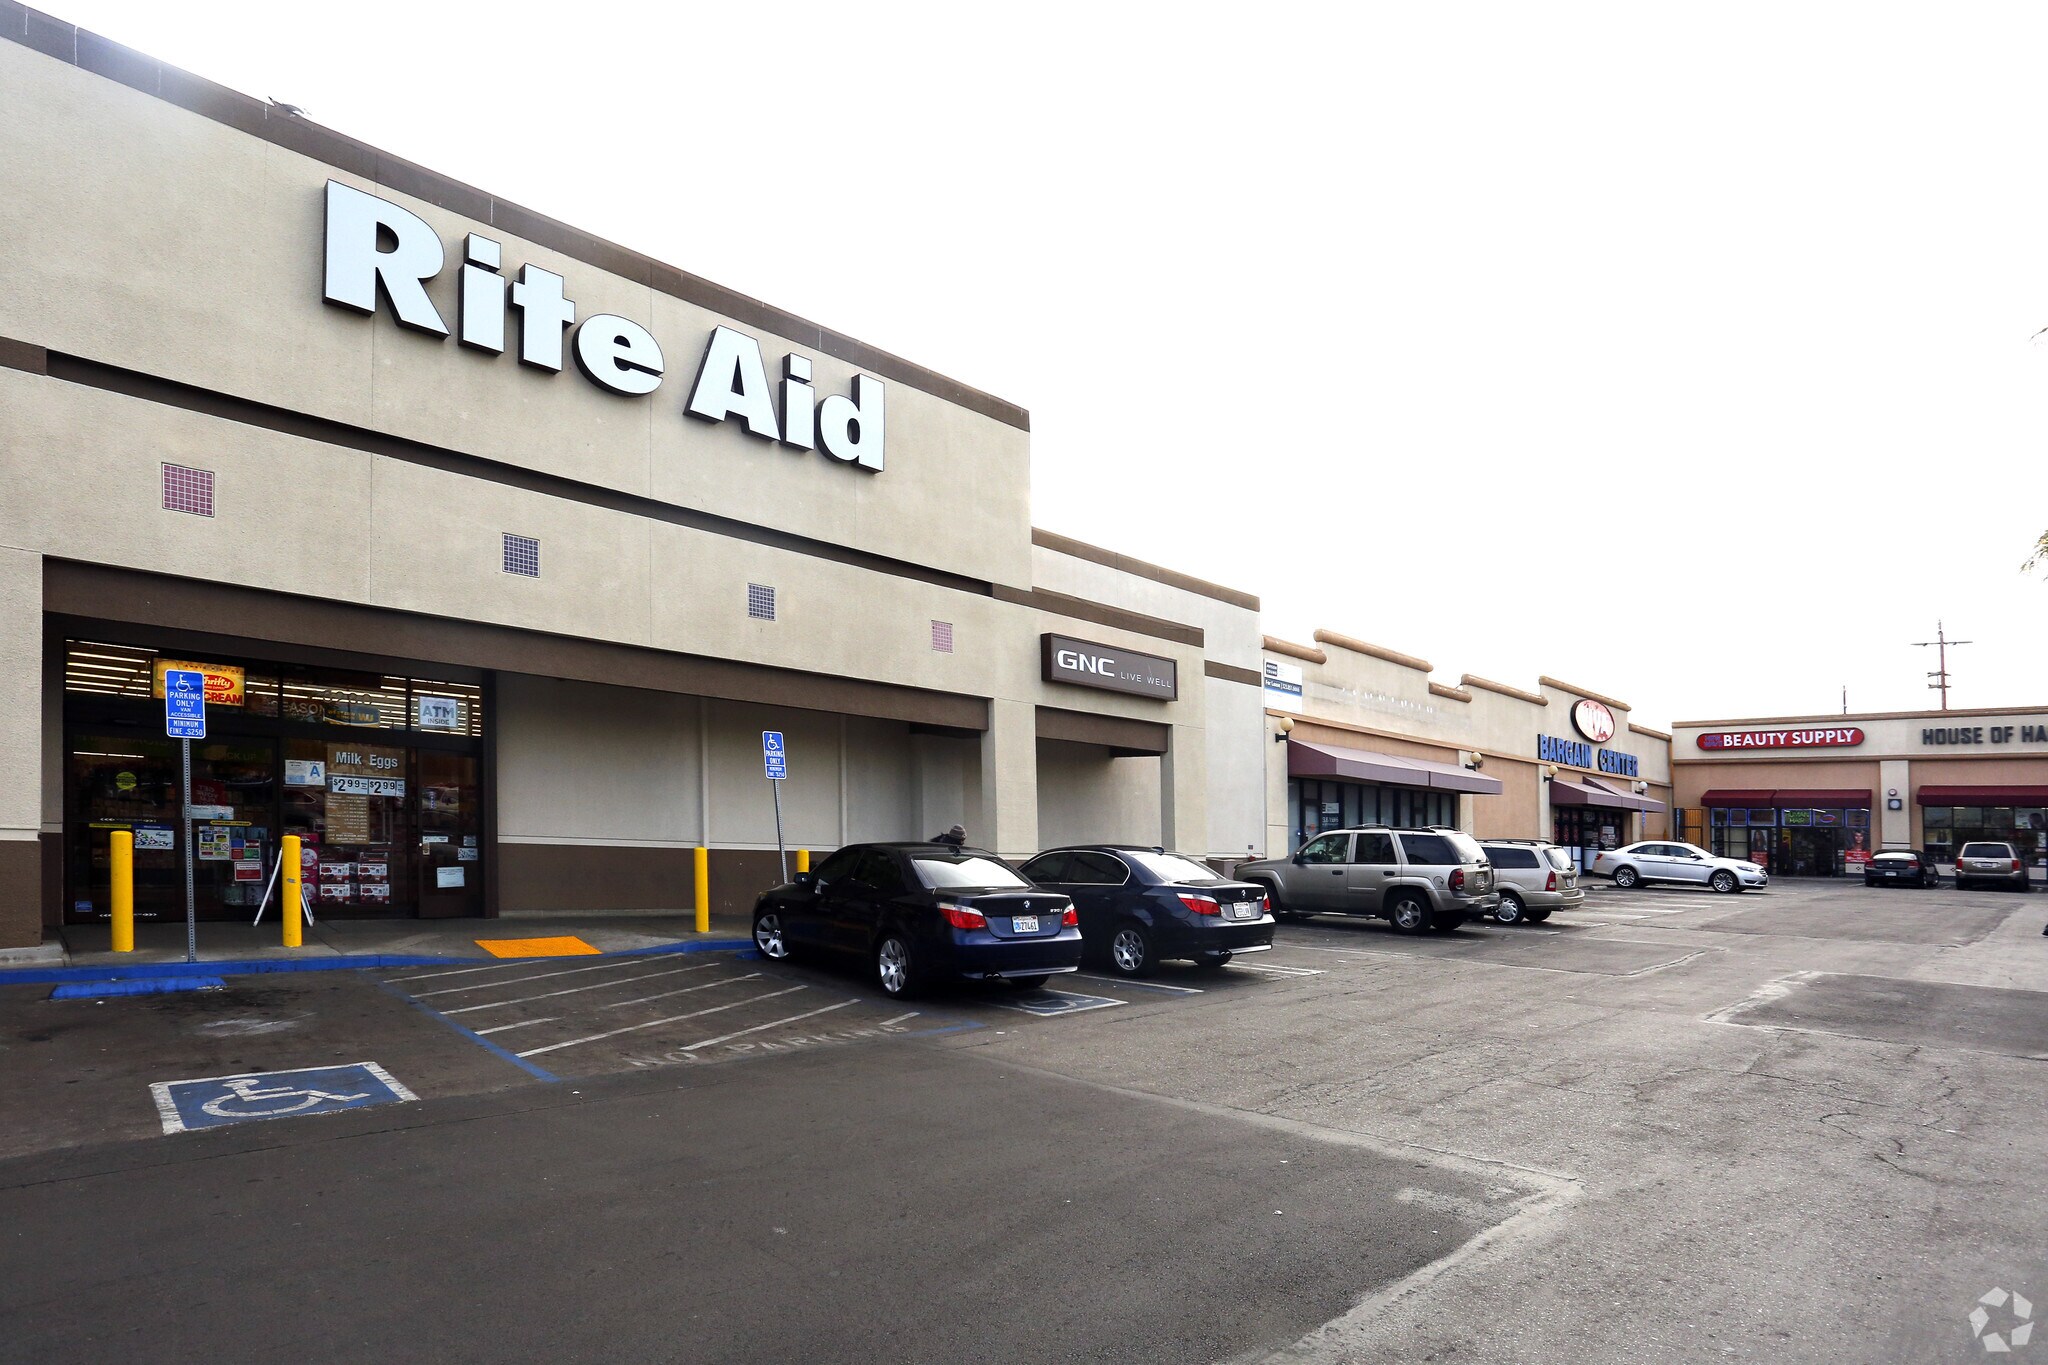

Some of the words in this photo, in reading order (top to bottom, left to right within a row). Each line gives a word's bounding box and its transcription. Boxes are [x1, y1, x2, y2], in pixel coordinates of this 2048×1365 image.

[322, 178, 665, 398] Rite
[682, 324, 885, 475] Aid
[1057, 649, 1115, 678] GNC
[1120, 671, 1142, 683] LIVE
[1146, 676, 1172, 688] WELL
[169, 691, 201, 701] PARKING
[175, 699, 195, 708] ONLY
[422, 705, 455, 719] ATM
[173, 720, 199, 728] MINIMUM
[427, 718, 450, 726] INSIDE
[169, 727, 183, 735] FINE
[1723, 732, 1788, 747] BEAUTY
[1791, 729, 1855, 745] SUPPLY
[1922, 727, 1984, 745] HOUSE
[1990, 726, 2014, 744] OF
[1538, 734, 1593, 769] BARGAIN
[335, 751, 362, 765] Milk
[369, 754, 398, 769] Eggs
[1598, 748, 1639, 777] CENTER
[310, 765, 321, 777] A
[622, 1051, 699, 1067] NO
